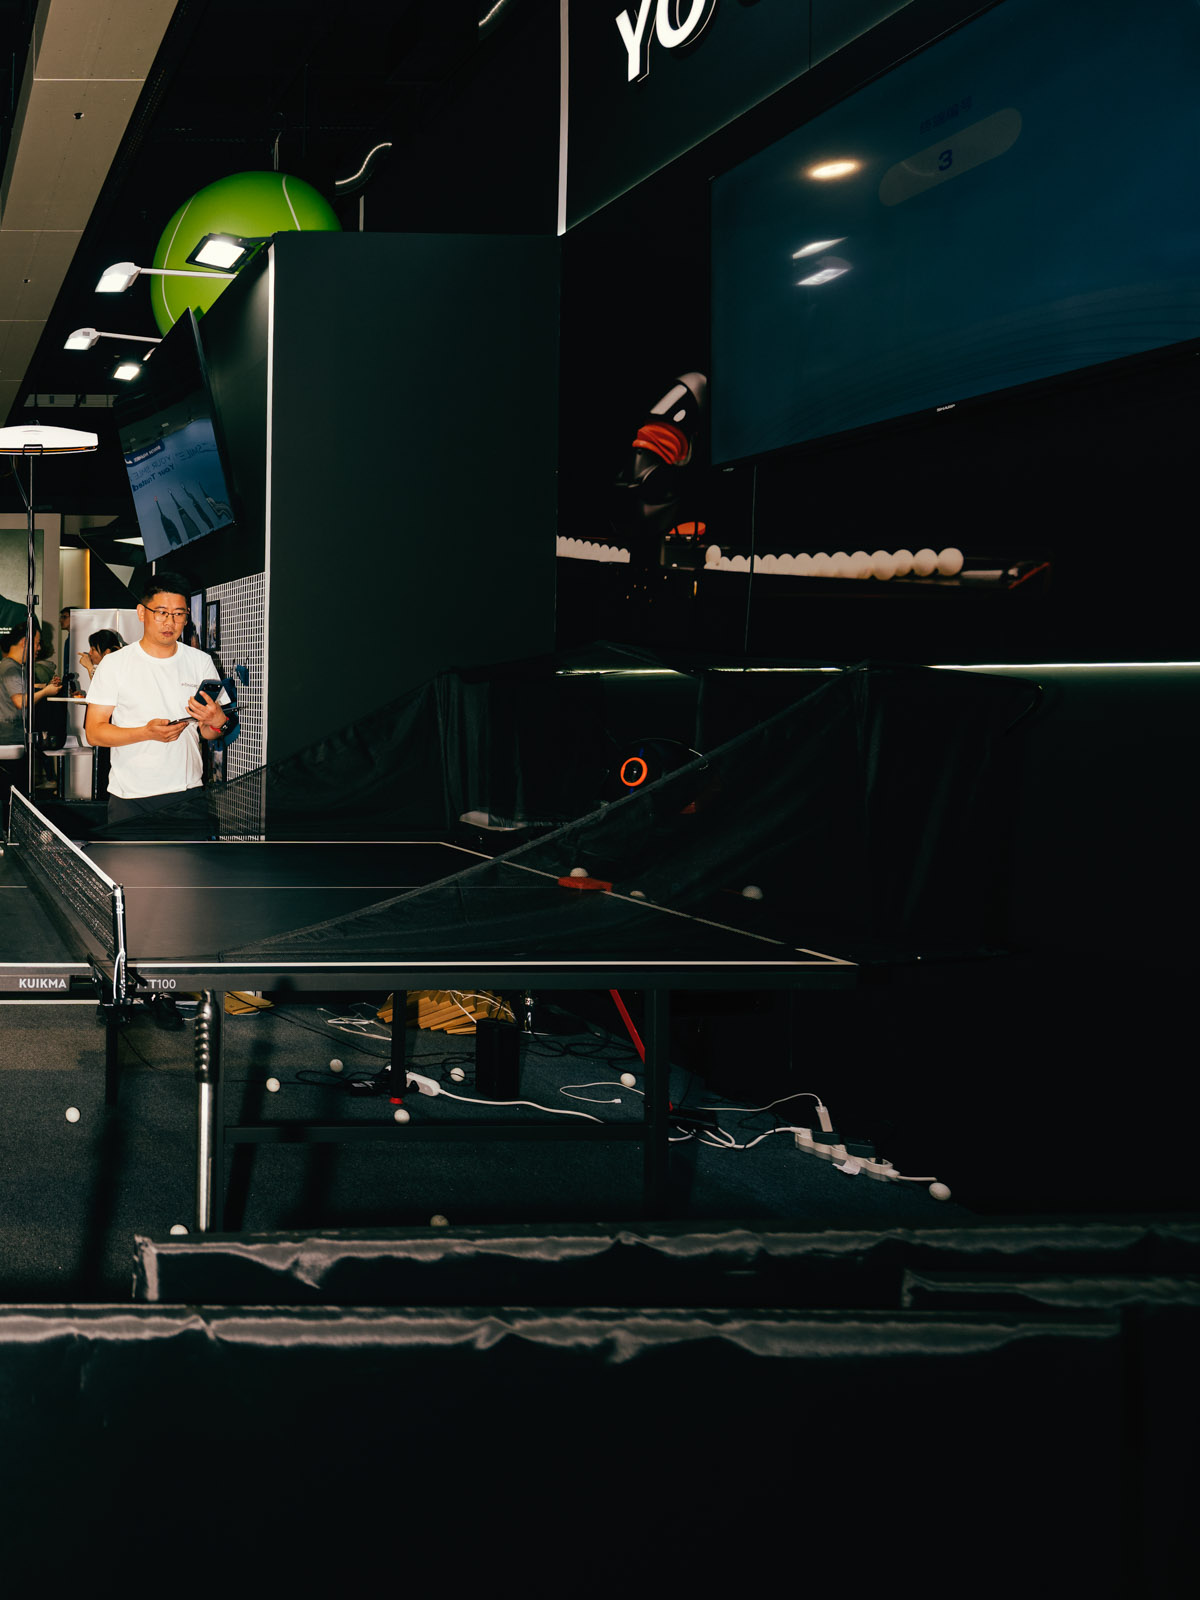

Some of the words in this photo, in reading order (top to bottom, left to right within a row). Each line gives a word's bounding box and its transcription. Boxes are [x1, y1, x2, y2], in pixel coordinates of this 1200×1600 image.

[938, 149, 953, 171] 3
[18, 978, 67, 989] KUIKMA
[136, 978, 177, 989] T100
